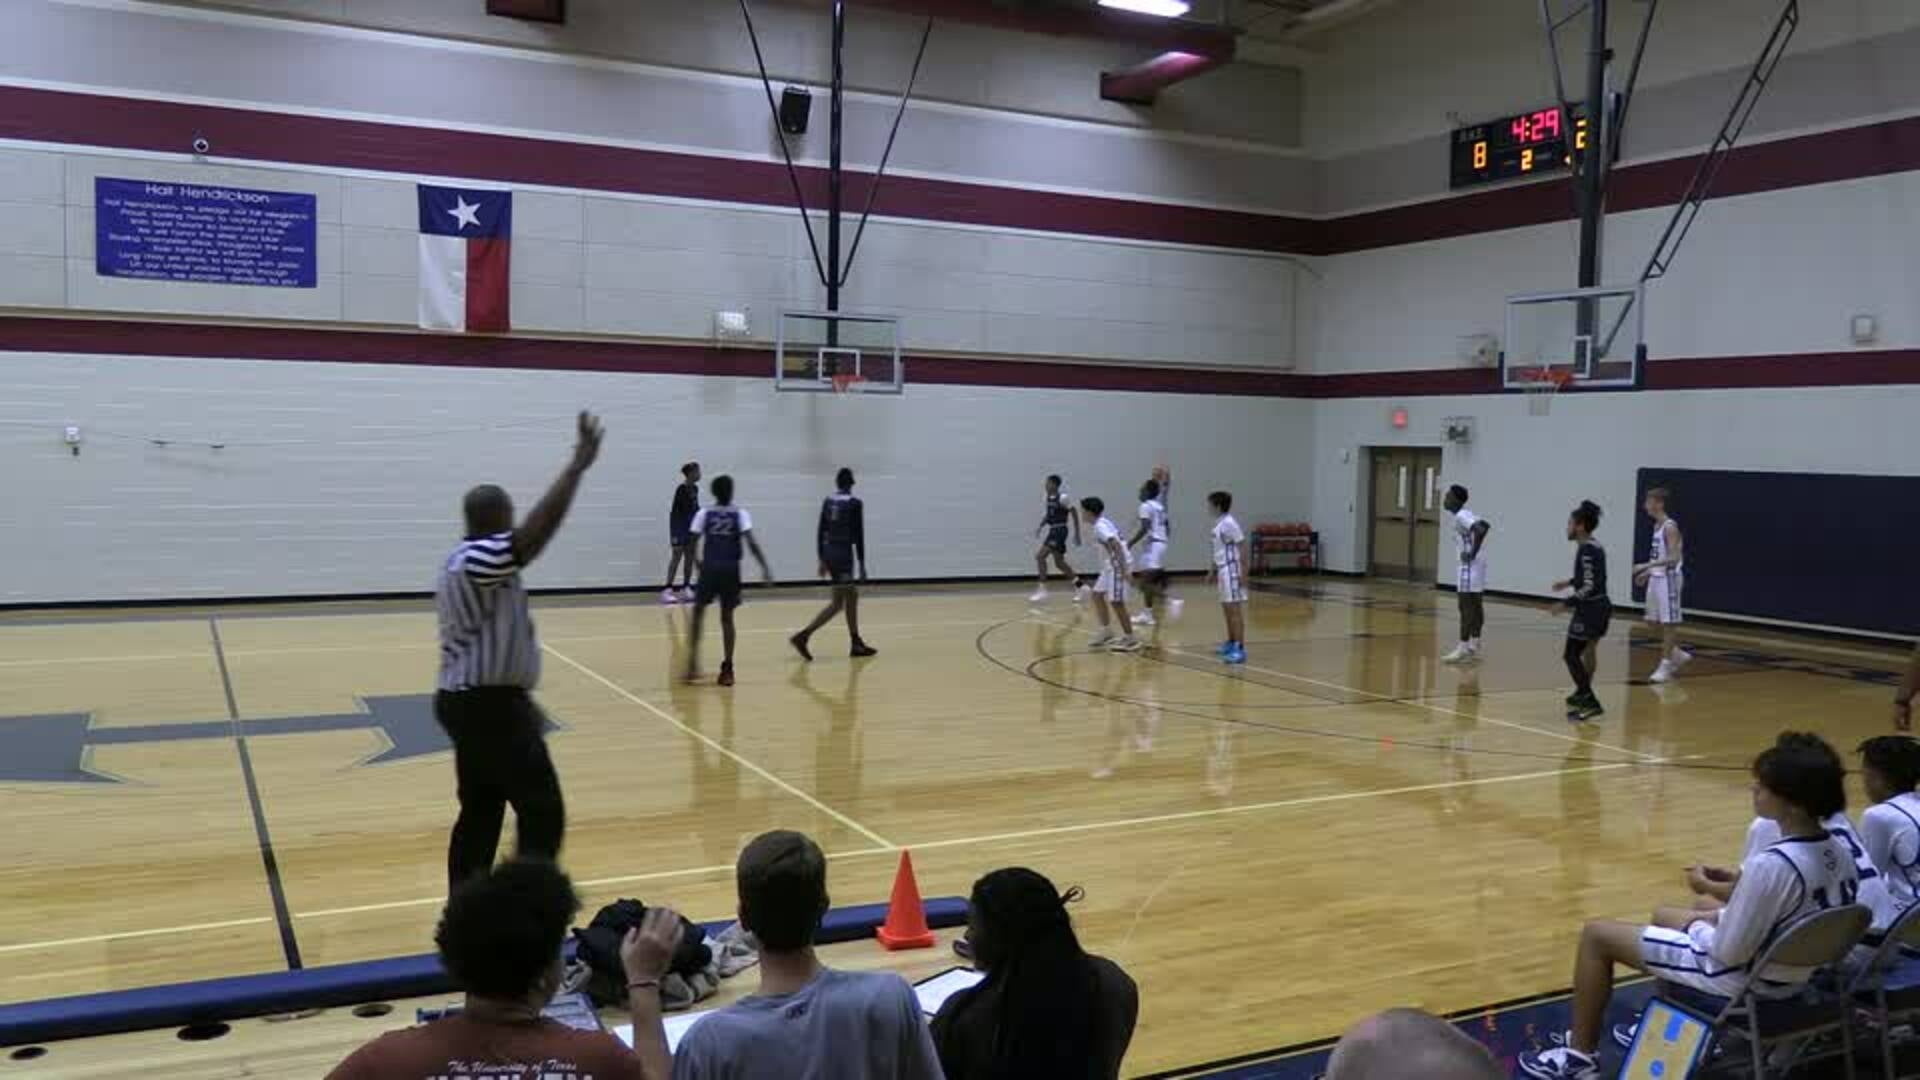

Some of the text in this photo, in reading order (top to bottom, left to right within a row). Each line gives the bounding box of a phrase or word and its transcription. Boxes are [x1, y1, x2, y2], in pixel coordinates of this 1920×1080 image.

[1511, 108, 1560, 143] 4:29
[1473, 141, 1487, 169] 8
[1521, 149, 1533, 171] 2
[180, 186, 269, 203] Hendrickson
[710, 517, 735, 535] 22
[448, 1060, 468, 1073] The
[531, 1060, 543, 1073] of
[547, 1059, 577, 1071] Texas
